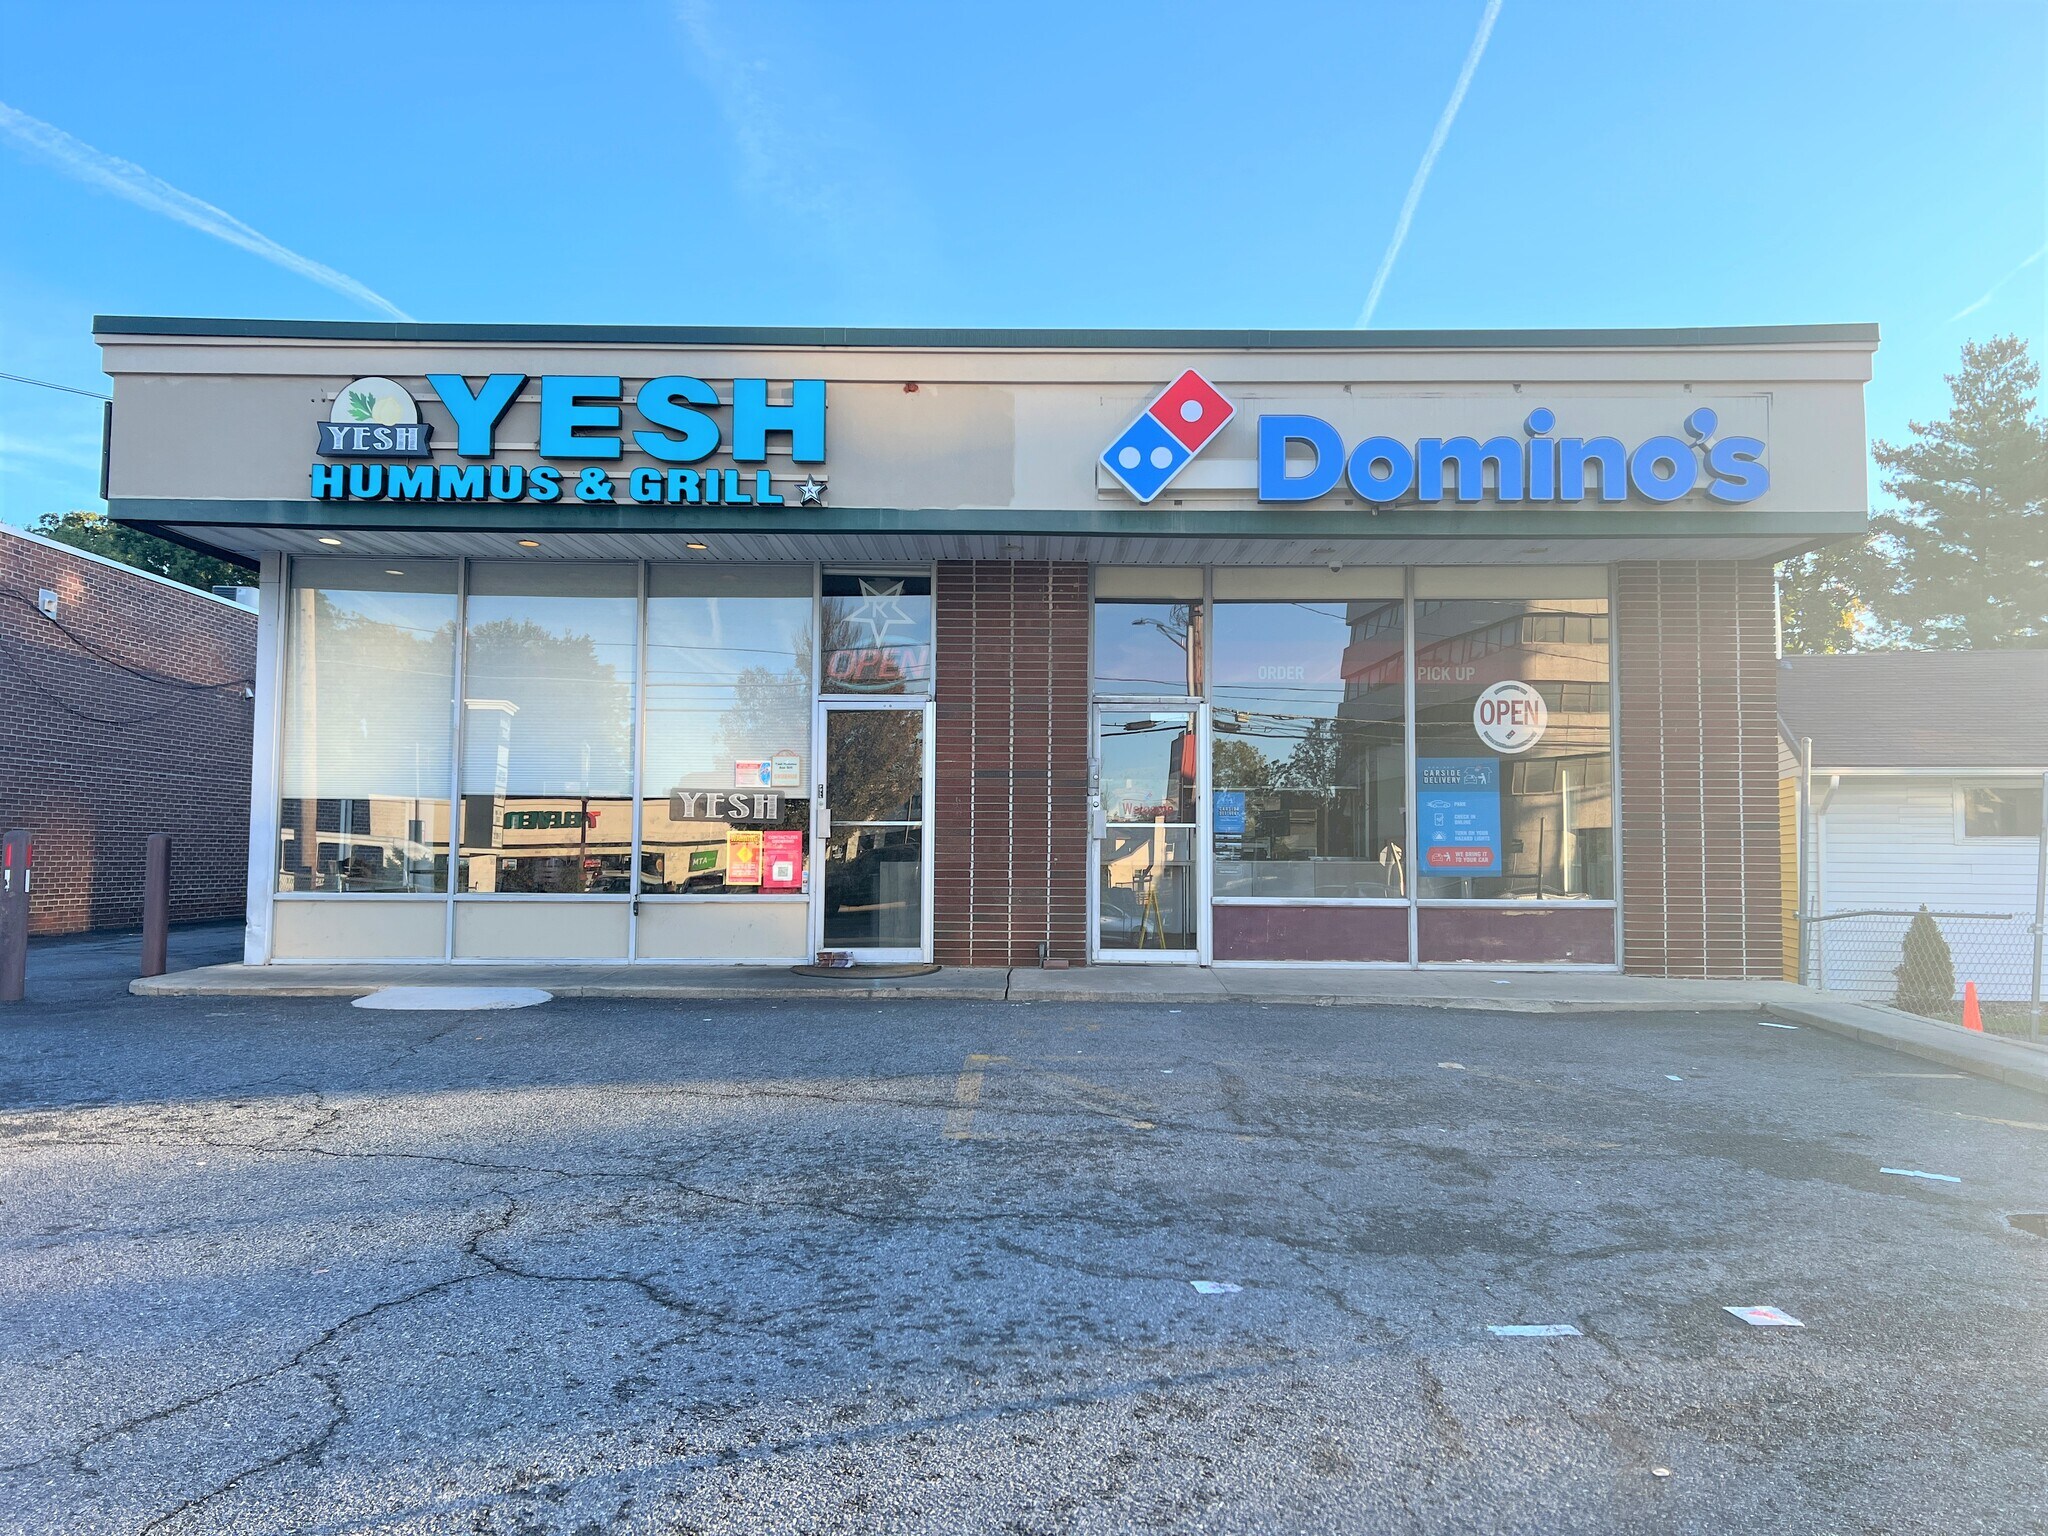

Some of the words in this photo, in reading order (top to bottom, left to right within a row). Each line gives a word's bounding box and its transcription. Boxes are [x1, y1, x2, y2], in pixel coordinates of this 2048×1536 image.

[425, 373, 828, 463] YESH
[327, 426, 418, 451] YESH
[1257, 407, 1770, 505] Domino's
[311, 463, 563, 502] HUMMUS
[575, 467, 616, 504] &
[629, 467, 785, 506] GRILL
[826, 646, 929, 680] OPEN
[1257, 665, 1304, 681] ORDER
[1417, 666, 1451, 681] PICK
[1455, 666, 1475, 681] UP
[1480, 699, 1539, 726] OPEN
[1423, 769, 1461, 777] CARSIDE
[1423, 776, 1461, 784] DELIVERY
[677, 791, 779, 820] YESH
